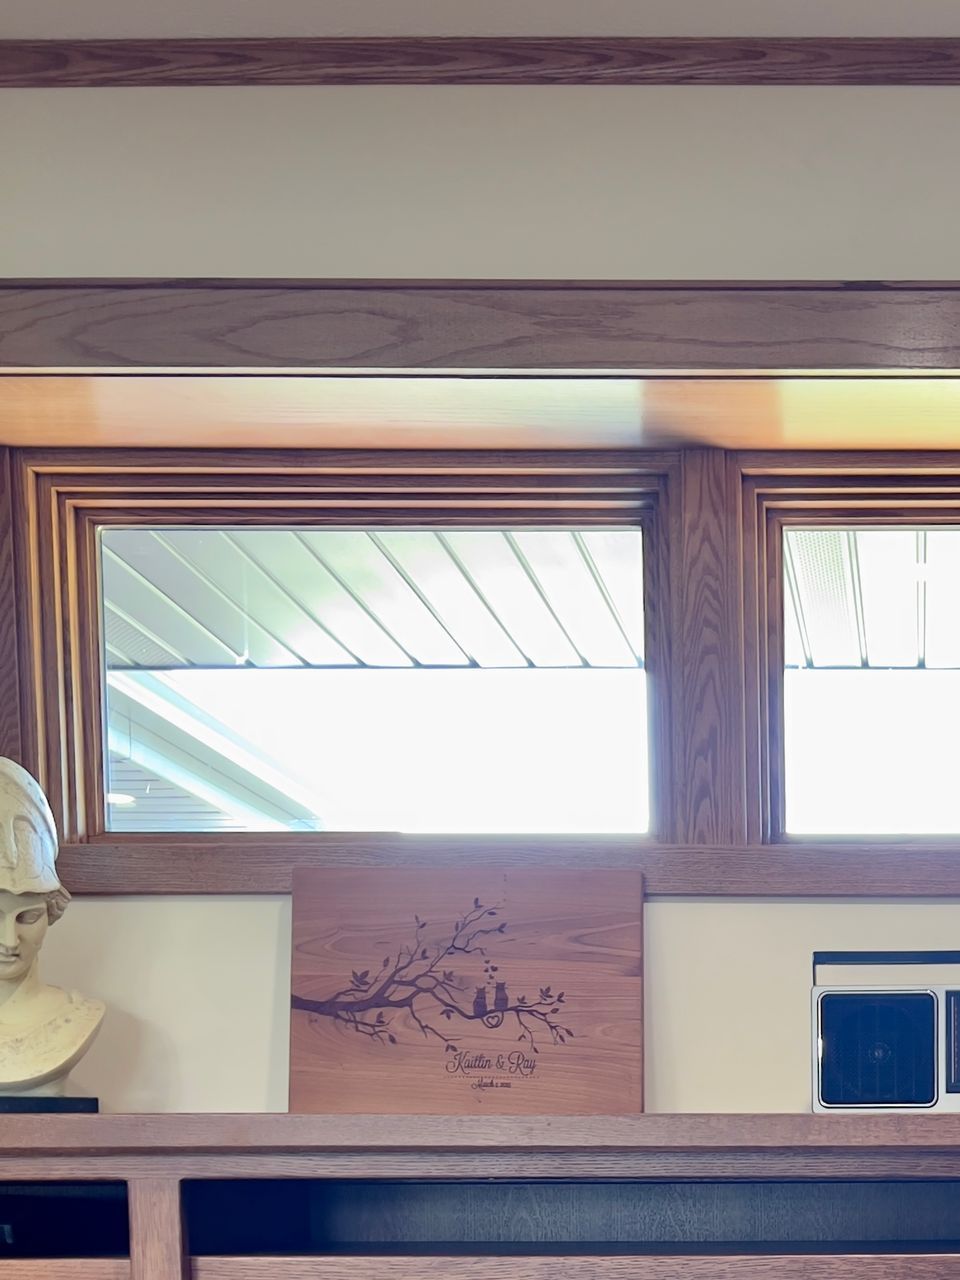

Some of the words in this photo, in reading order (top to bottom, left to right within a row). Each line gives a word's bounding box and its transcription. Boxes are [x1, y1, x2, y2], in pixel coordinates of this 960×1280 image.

[446, 1051, 491, 1074] Kaitlin
[496, 1055, 506, 1070] &
[508, 1051, 536, 1076] Ray
